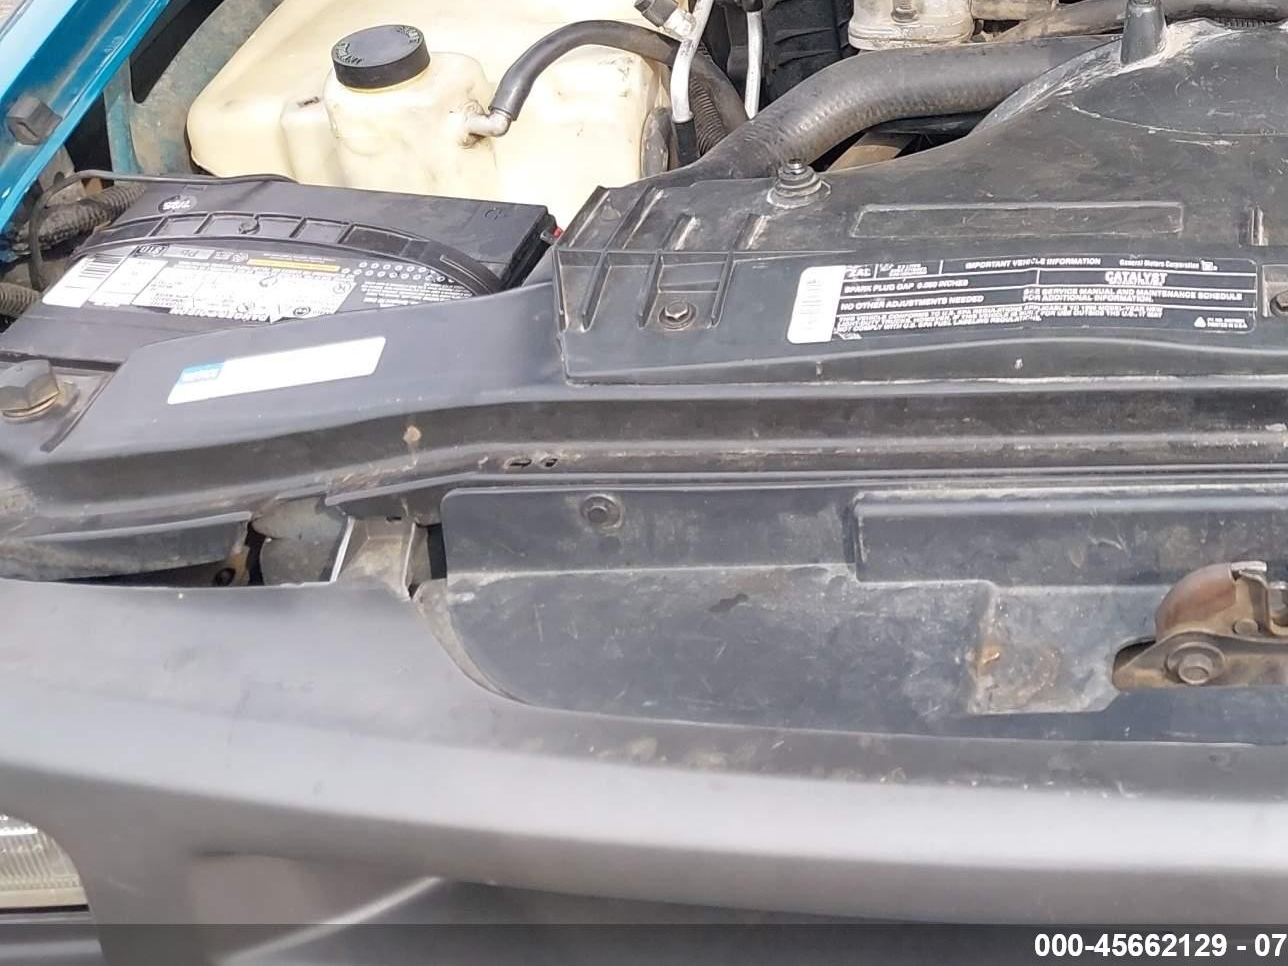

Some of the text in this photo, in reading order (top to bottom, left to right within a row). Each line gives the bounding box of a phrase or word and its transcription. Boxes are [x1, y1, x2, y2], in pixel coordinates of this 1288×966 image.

[965, 260, 1012, 269] IMPORTANT
[1012, 258, 1046, 266] VEHICLE
[1105, 271, 1168, 284] CATALYST
[844, 285, 872, 293] SPARK
[896, 282, 915, 290] GAP
[1136, 289, 1197, 299] MAINTENANCE
[1197, 292, 1243, 301] SCHEDULE
[840, 295, 984, 311] NO OTHER ADJUSTMENTS NEEDED
